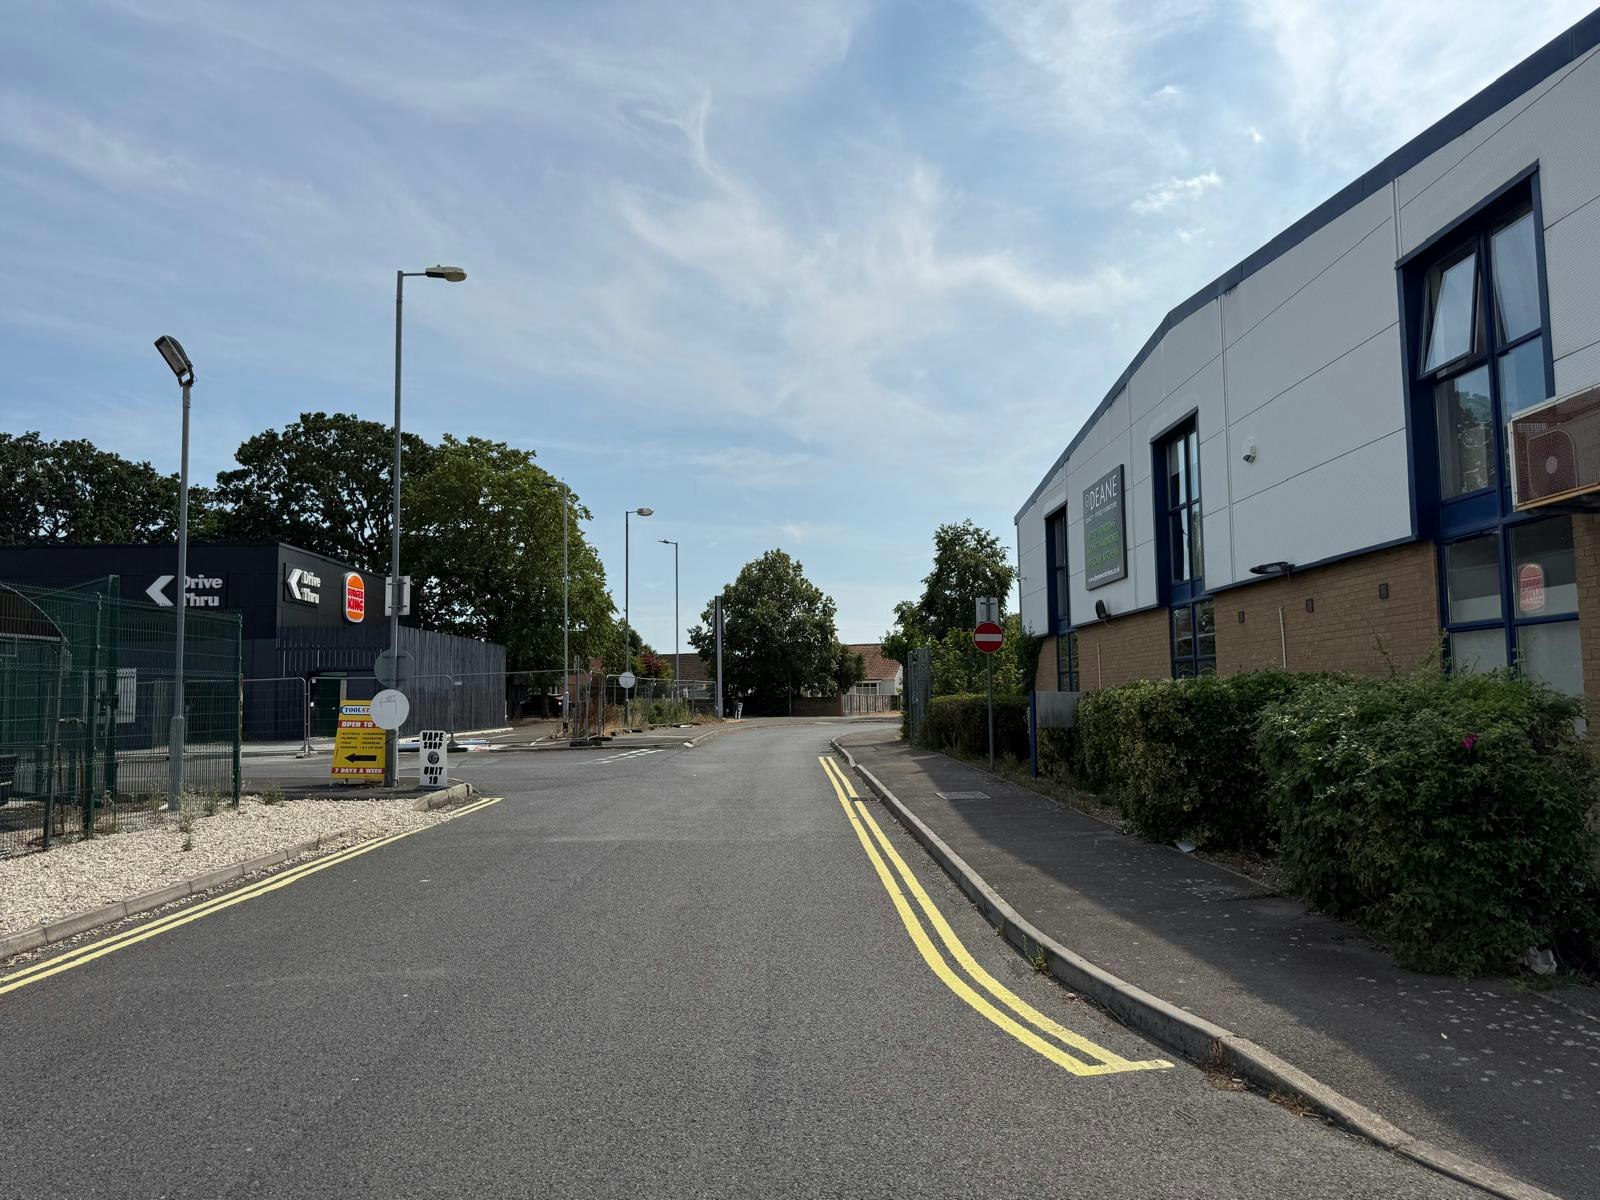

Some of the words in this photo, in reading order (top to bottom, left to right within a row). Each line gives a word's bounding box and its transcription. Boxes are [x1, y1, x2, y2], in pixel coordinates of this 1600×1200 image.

[1090, 475, 1117, 510] DEANE
[301, 571, 321, 588] Drive
[301, 588, 320, 604] Thru
[347, 597, 363, 612] KING
[422, 732, 444, 741] VAPE
[423, 741, 442, 749] SHOP
[423, 766, 443, 775] UNIT
